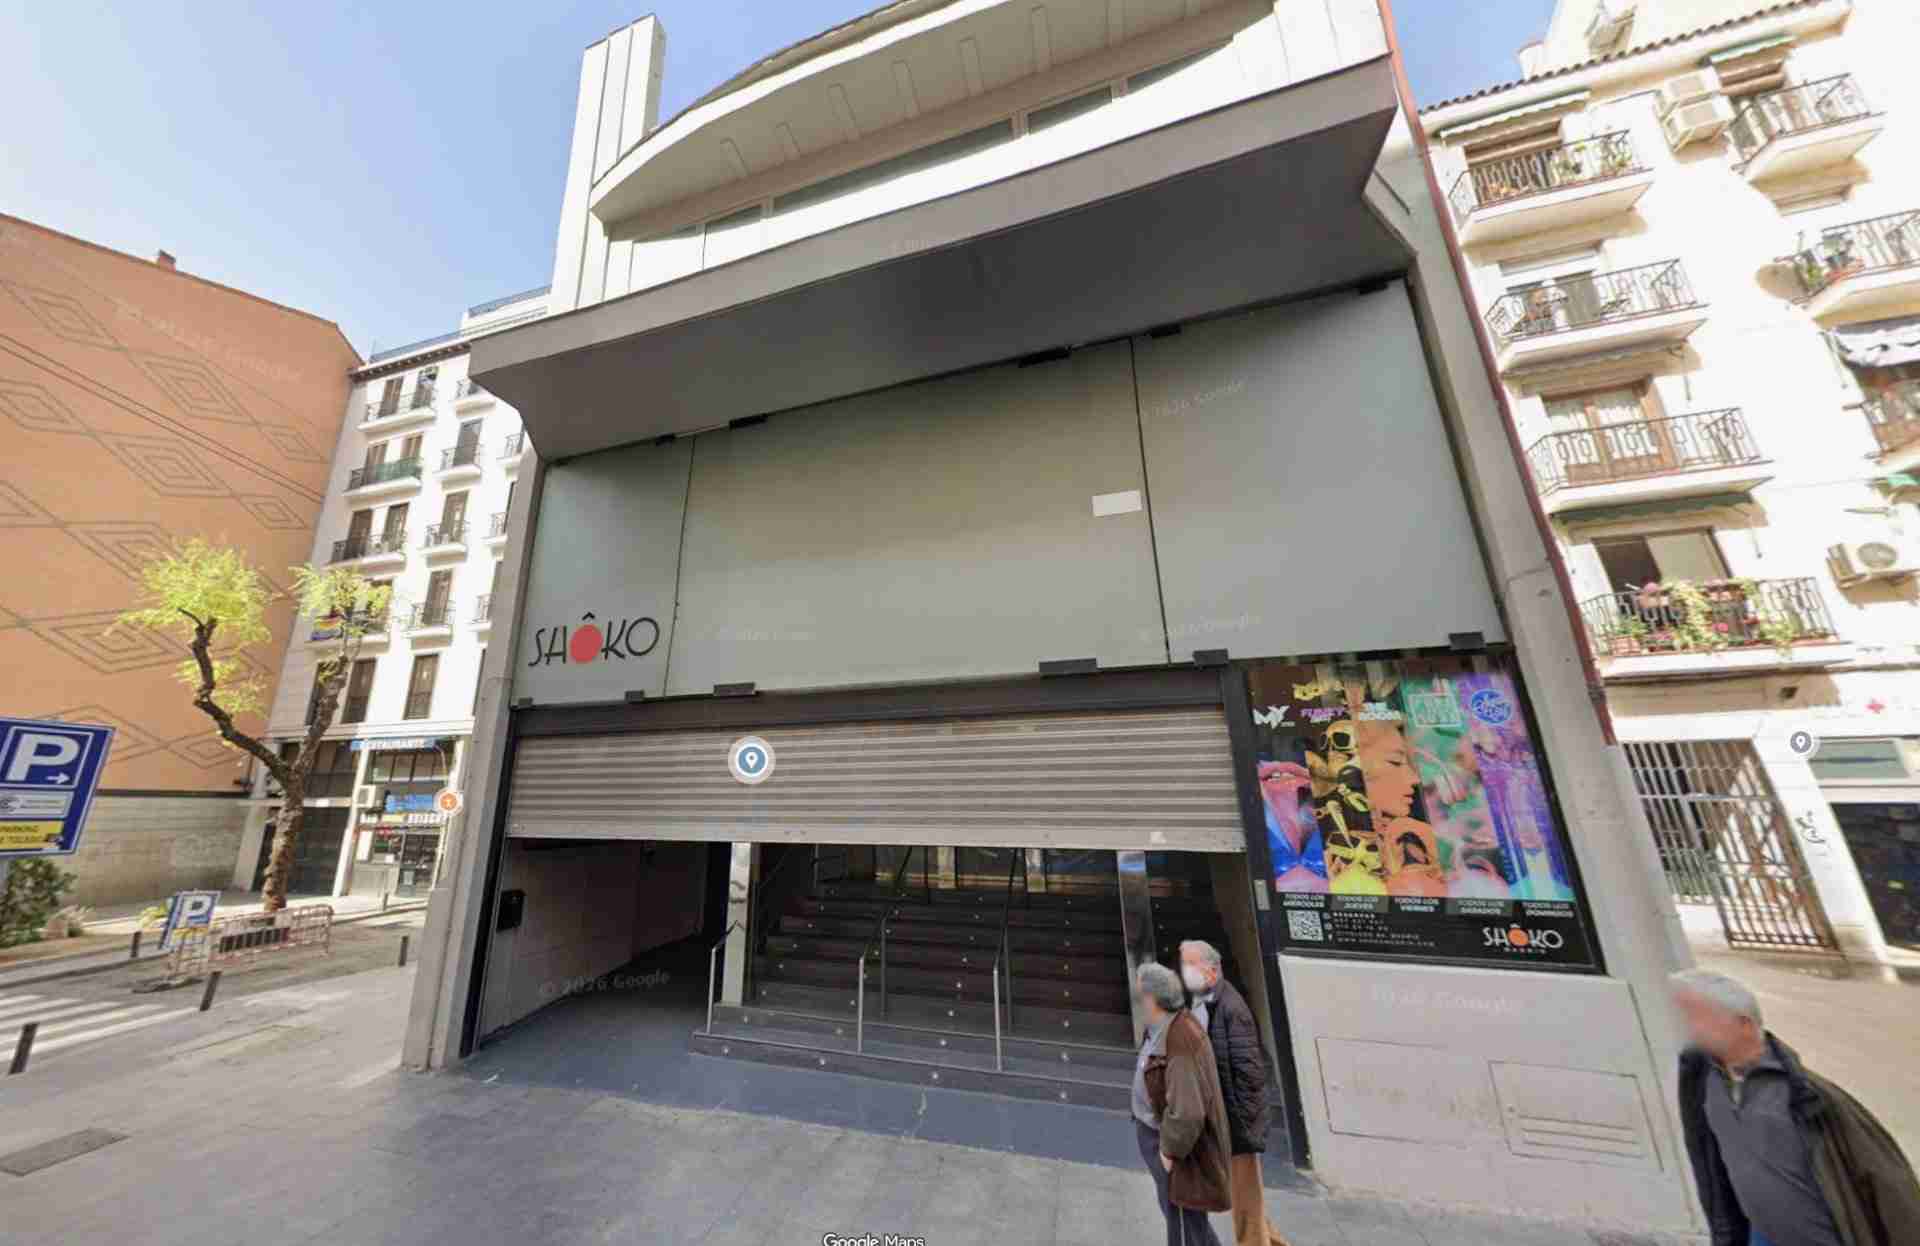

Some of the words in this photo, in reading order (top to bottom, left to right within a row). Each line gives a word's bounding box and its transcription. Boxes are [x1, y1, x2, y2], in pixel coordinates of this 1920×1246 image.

[528, 612, 660, 667] SHÔKO
[5, 733, 79, 781] P
[178, 896, 212, 928] P
